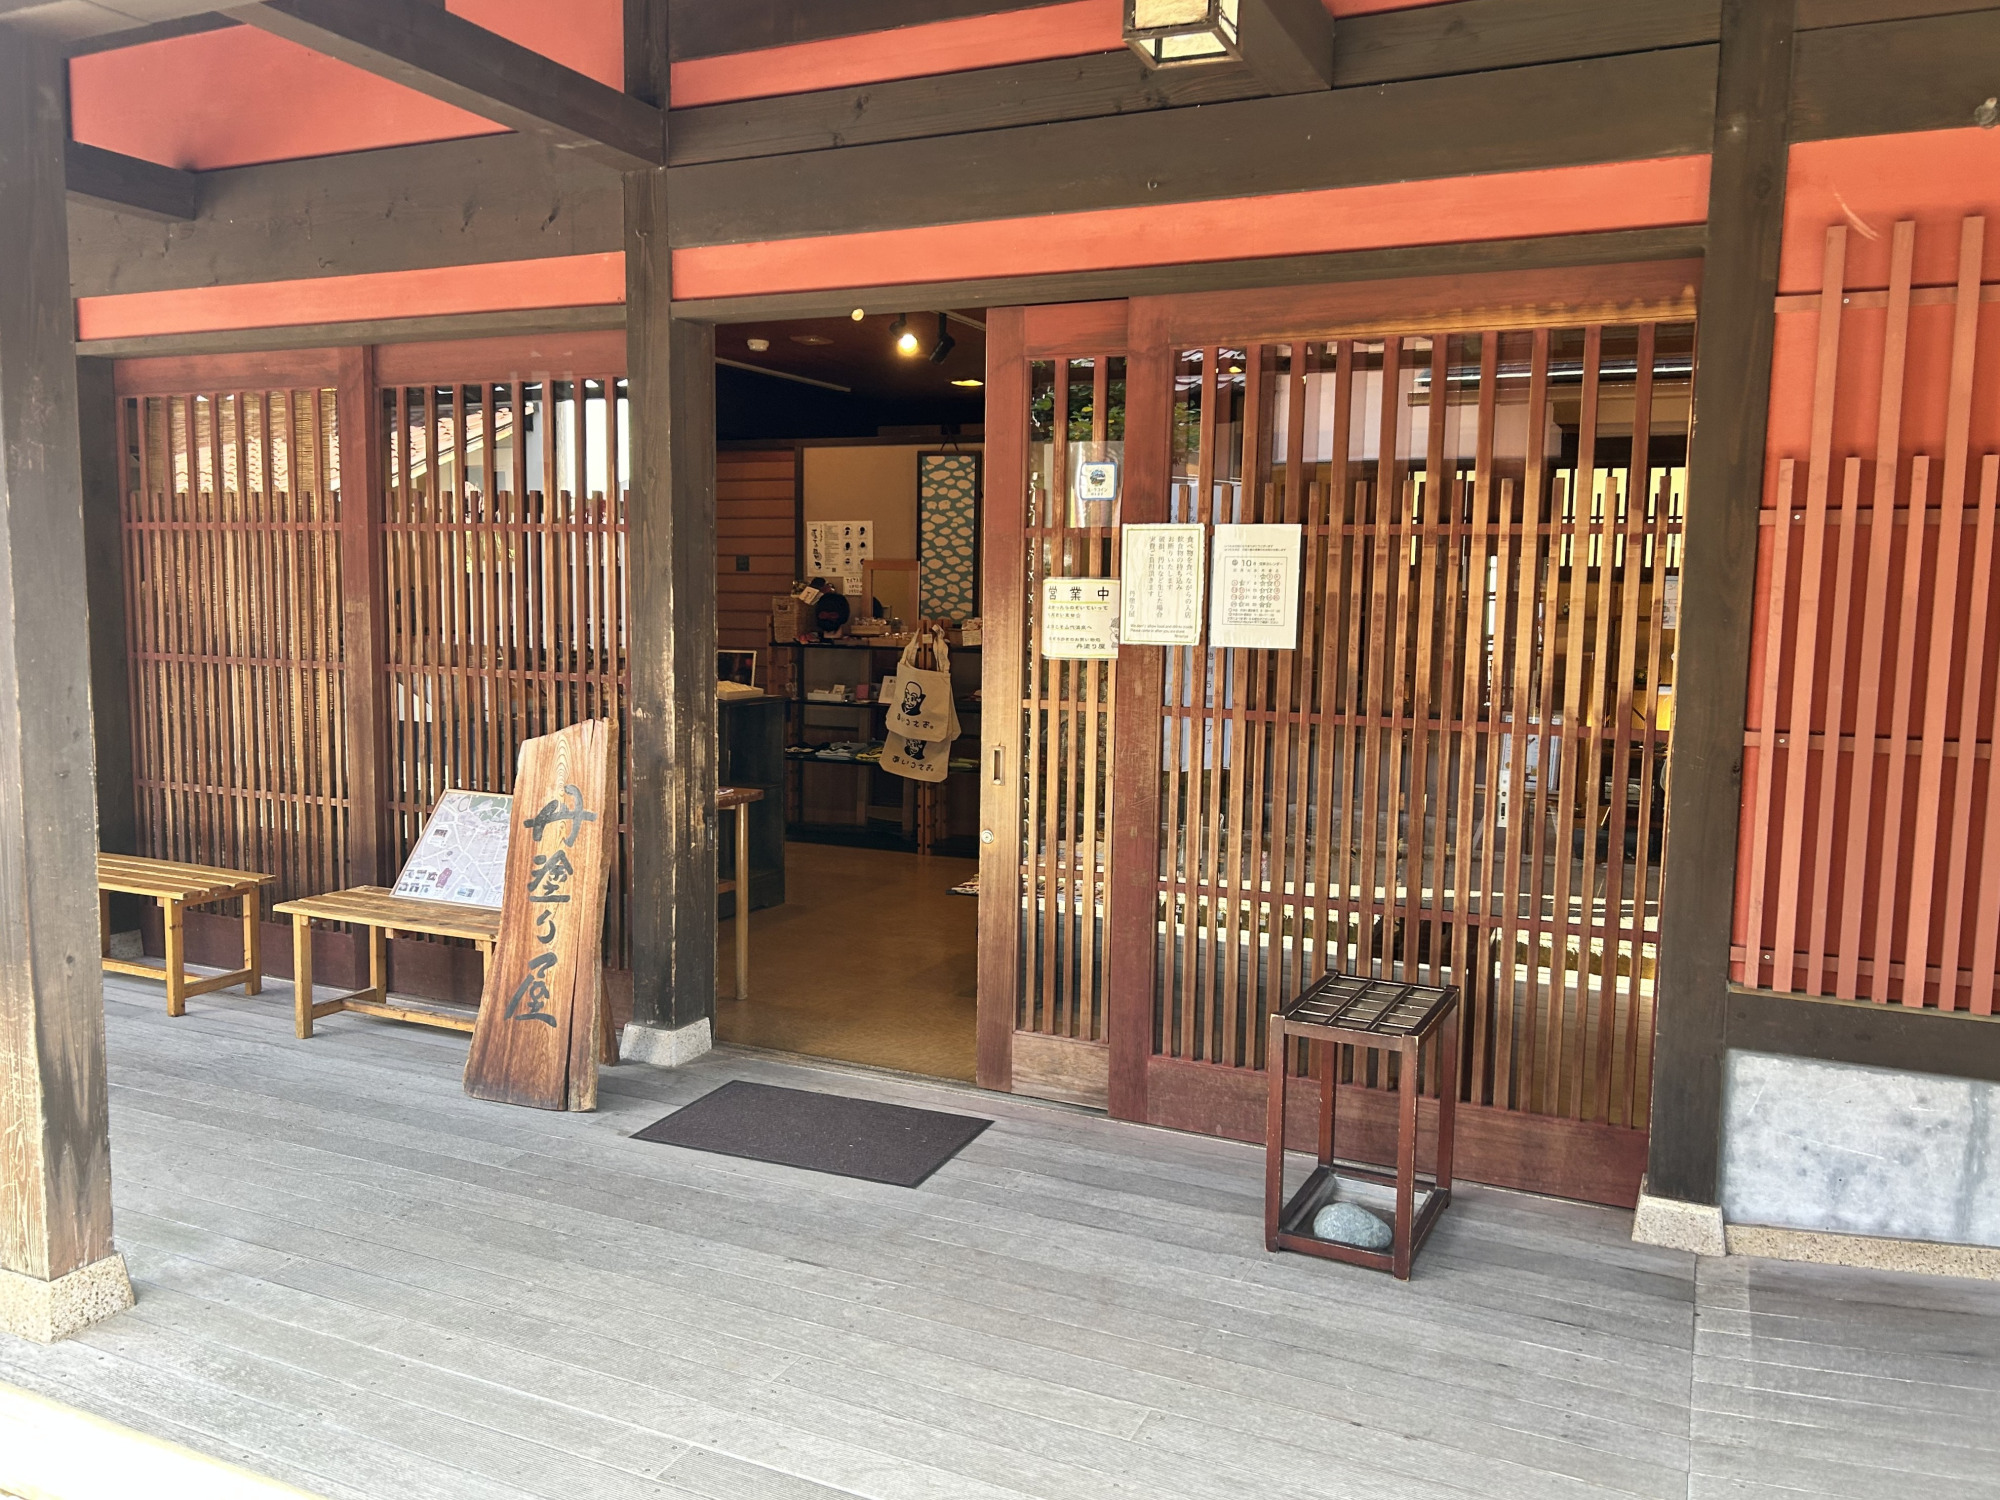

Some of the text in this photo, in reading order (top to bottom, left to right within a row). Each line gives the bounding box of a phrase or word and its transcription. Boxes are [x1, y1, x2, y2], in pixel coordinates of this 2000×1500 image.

[1148, 535, 1156, 597] 実費ご負担頂きます
[1167, 535, 1175, 590] お断りいたします
[1176, 535, 1185, 591] 飲食物の持ち込み
[1185, 535, 1194, 619] 食べ物を食べながらの入店
[1048, 585, 1110, 602] 営業中
[504, 784, 598, 1028] 丹塗り屋
